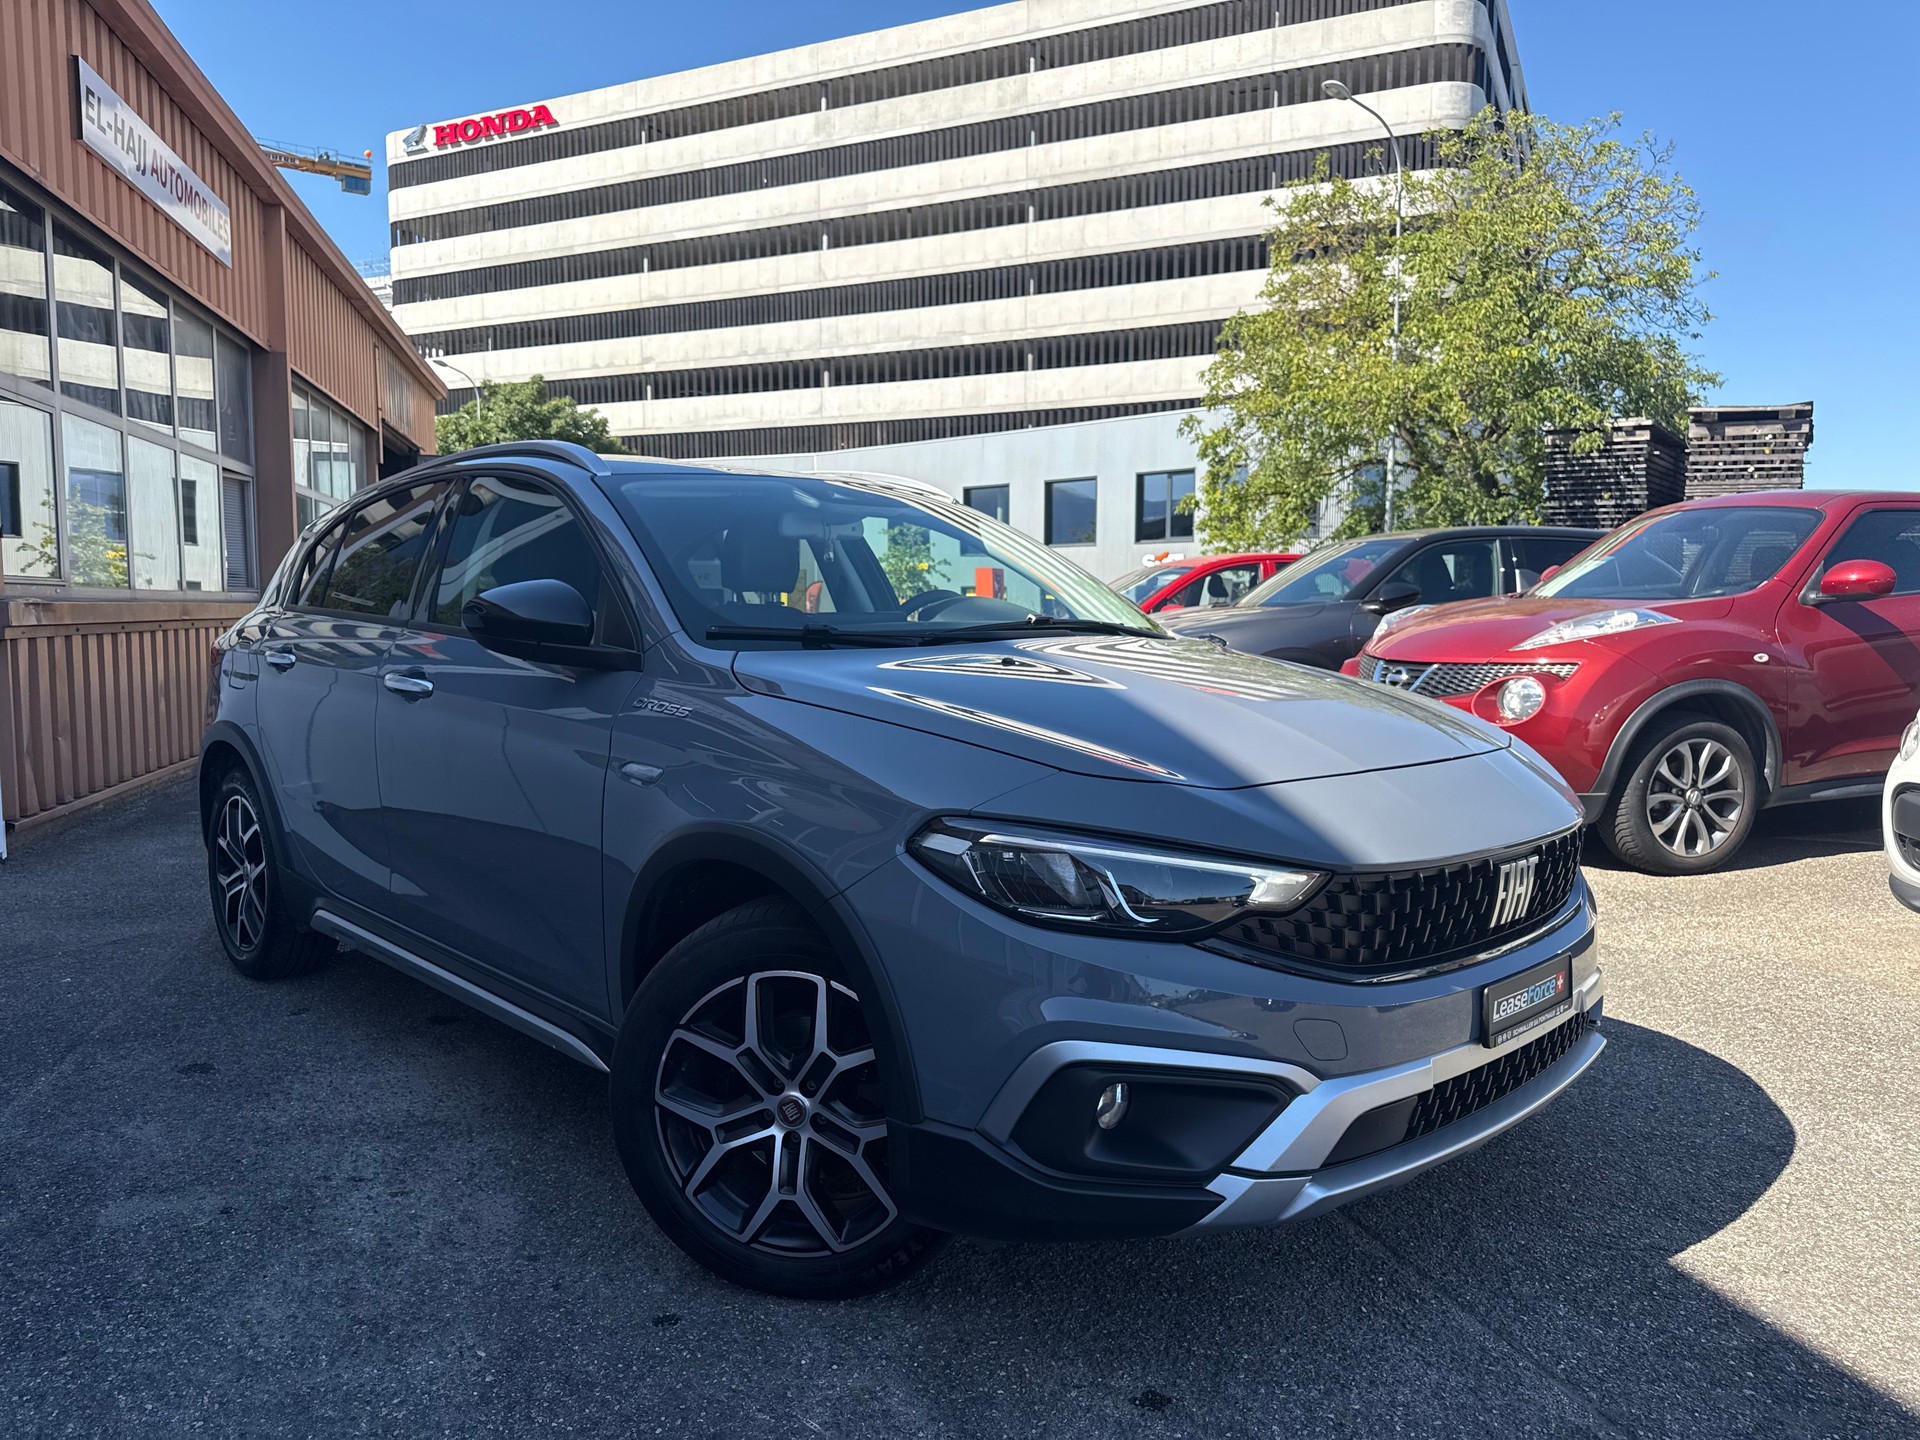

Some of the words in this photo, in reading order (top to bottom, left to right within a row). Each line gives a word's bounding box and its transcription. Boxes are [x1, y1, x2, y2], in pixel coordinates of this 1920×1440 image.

[433, 104, 557, 146] HONDA
[85, 85, 147, 177] EL-HAJJ
[151, 148, 229, 246] AUTOMOBILES
[632, 697, 694, 717] CROSS
[1489, 854, 1540, 928] FIAT
[1492, 977, 1556, 1020] LeaseForce
[781, 1102, 801, 1122] FIAT
